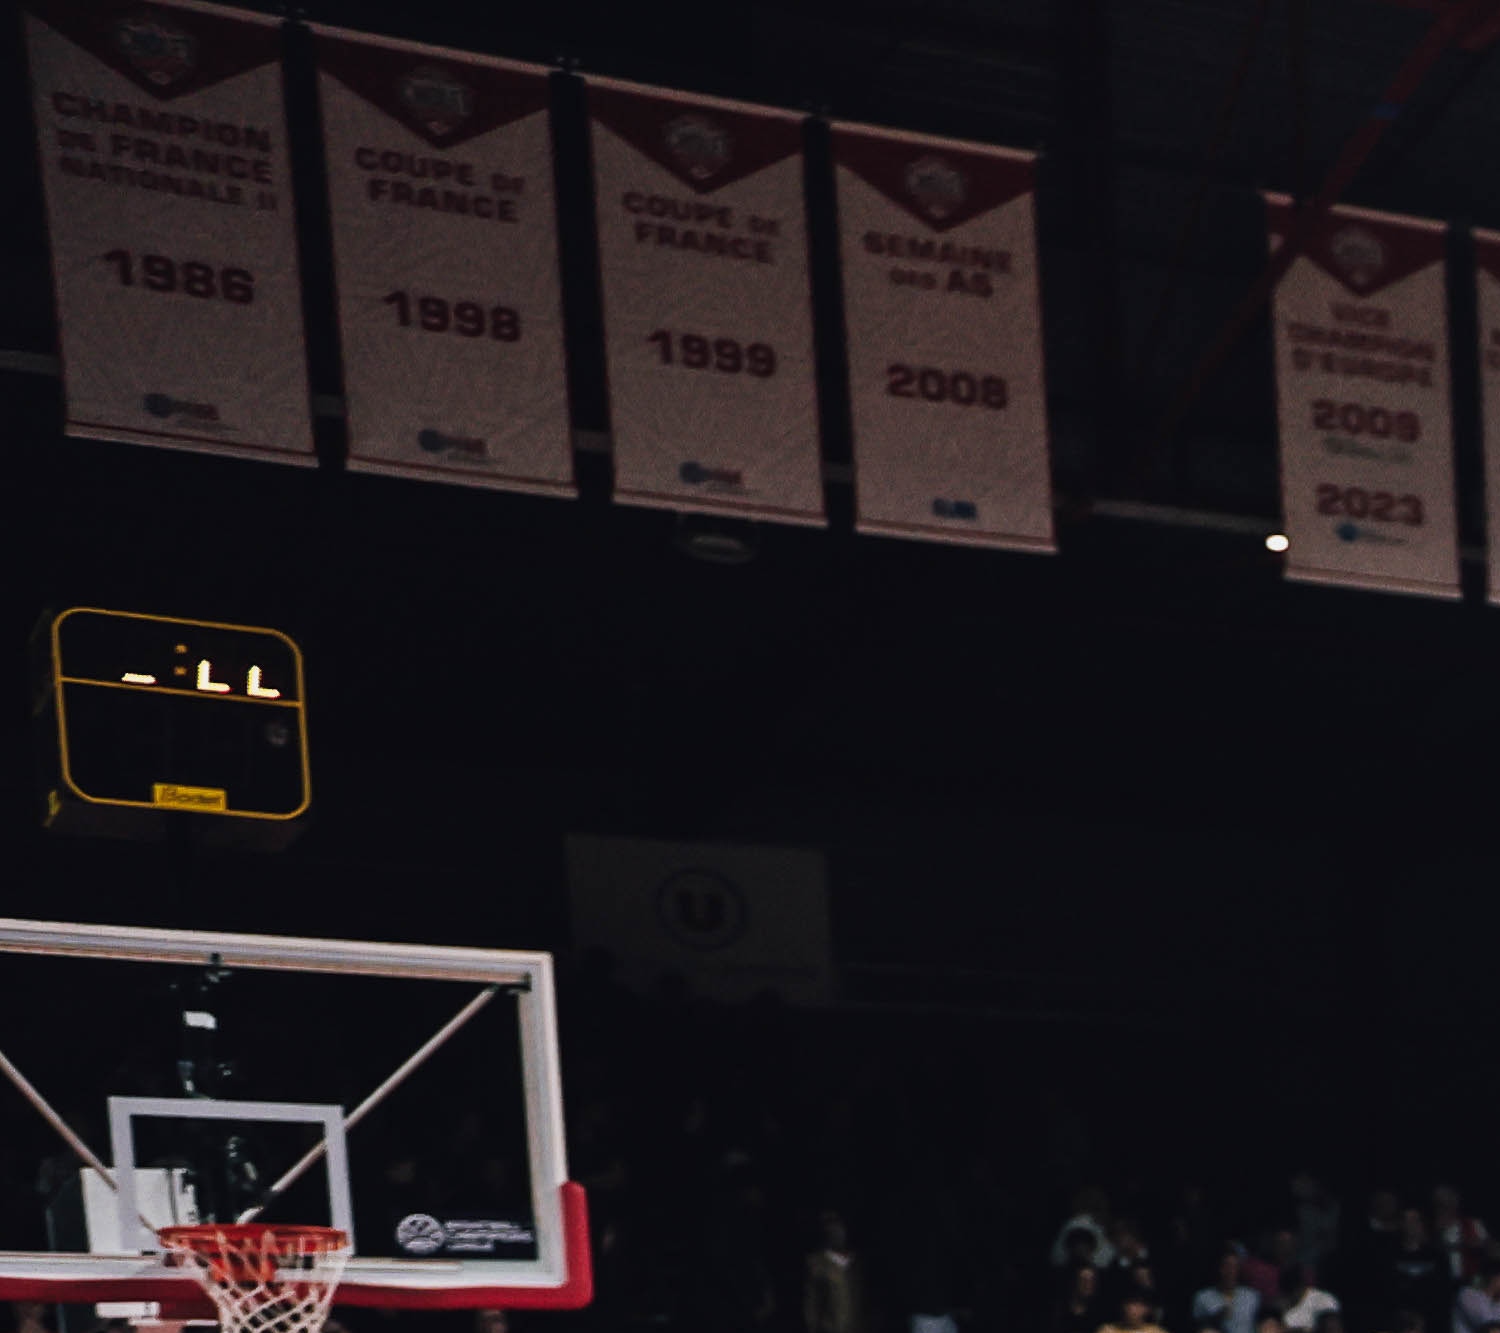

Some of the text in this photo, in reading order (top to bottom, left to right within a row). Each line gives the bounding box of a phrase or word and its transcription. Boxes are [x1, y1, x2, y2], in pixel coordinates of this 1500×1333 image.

[51, 91, 271, 150] CHAMPION
[59, 157, 243, 205] NATIONALE
[111, 133, 273, 184] FRANCE
[357, 148, 526, 195] COUPE DE
[370, 179, 520, 223] FRANCE
[621, 191, 732, 229] COUPE
[634, 222, 774, 264] FRANCE
[863, 230, 1012, 274] SEMAINE
[103, 249, 255, 304] 1986
[946, 270, 994, 299] AS
[384, 290, 522, 344] 1998
[648, 328, 777, 379] 1999
[885, 362, 1009, 411] 2008
